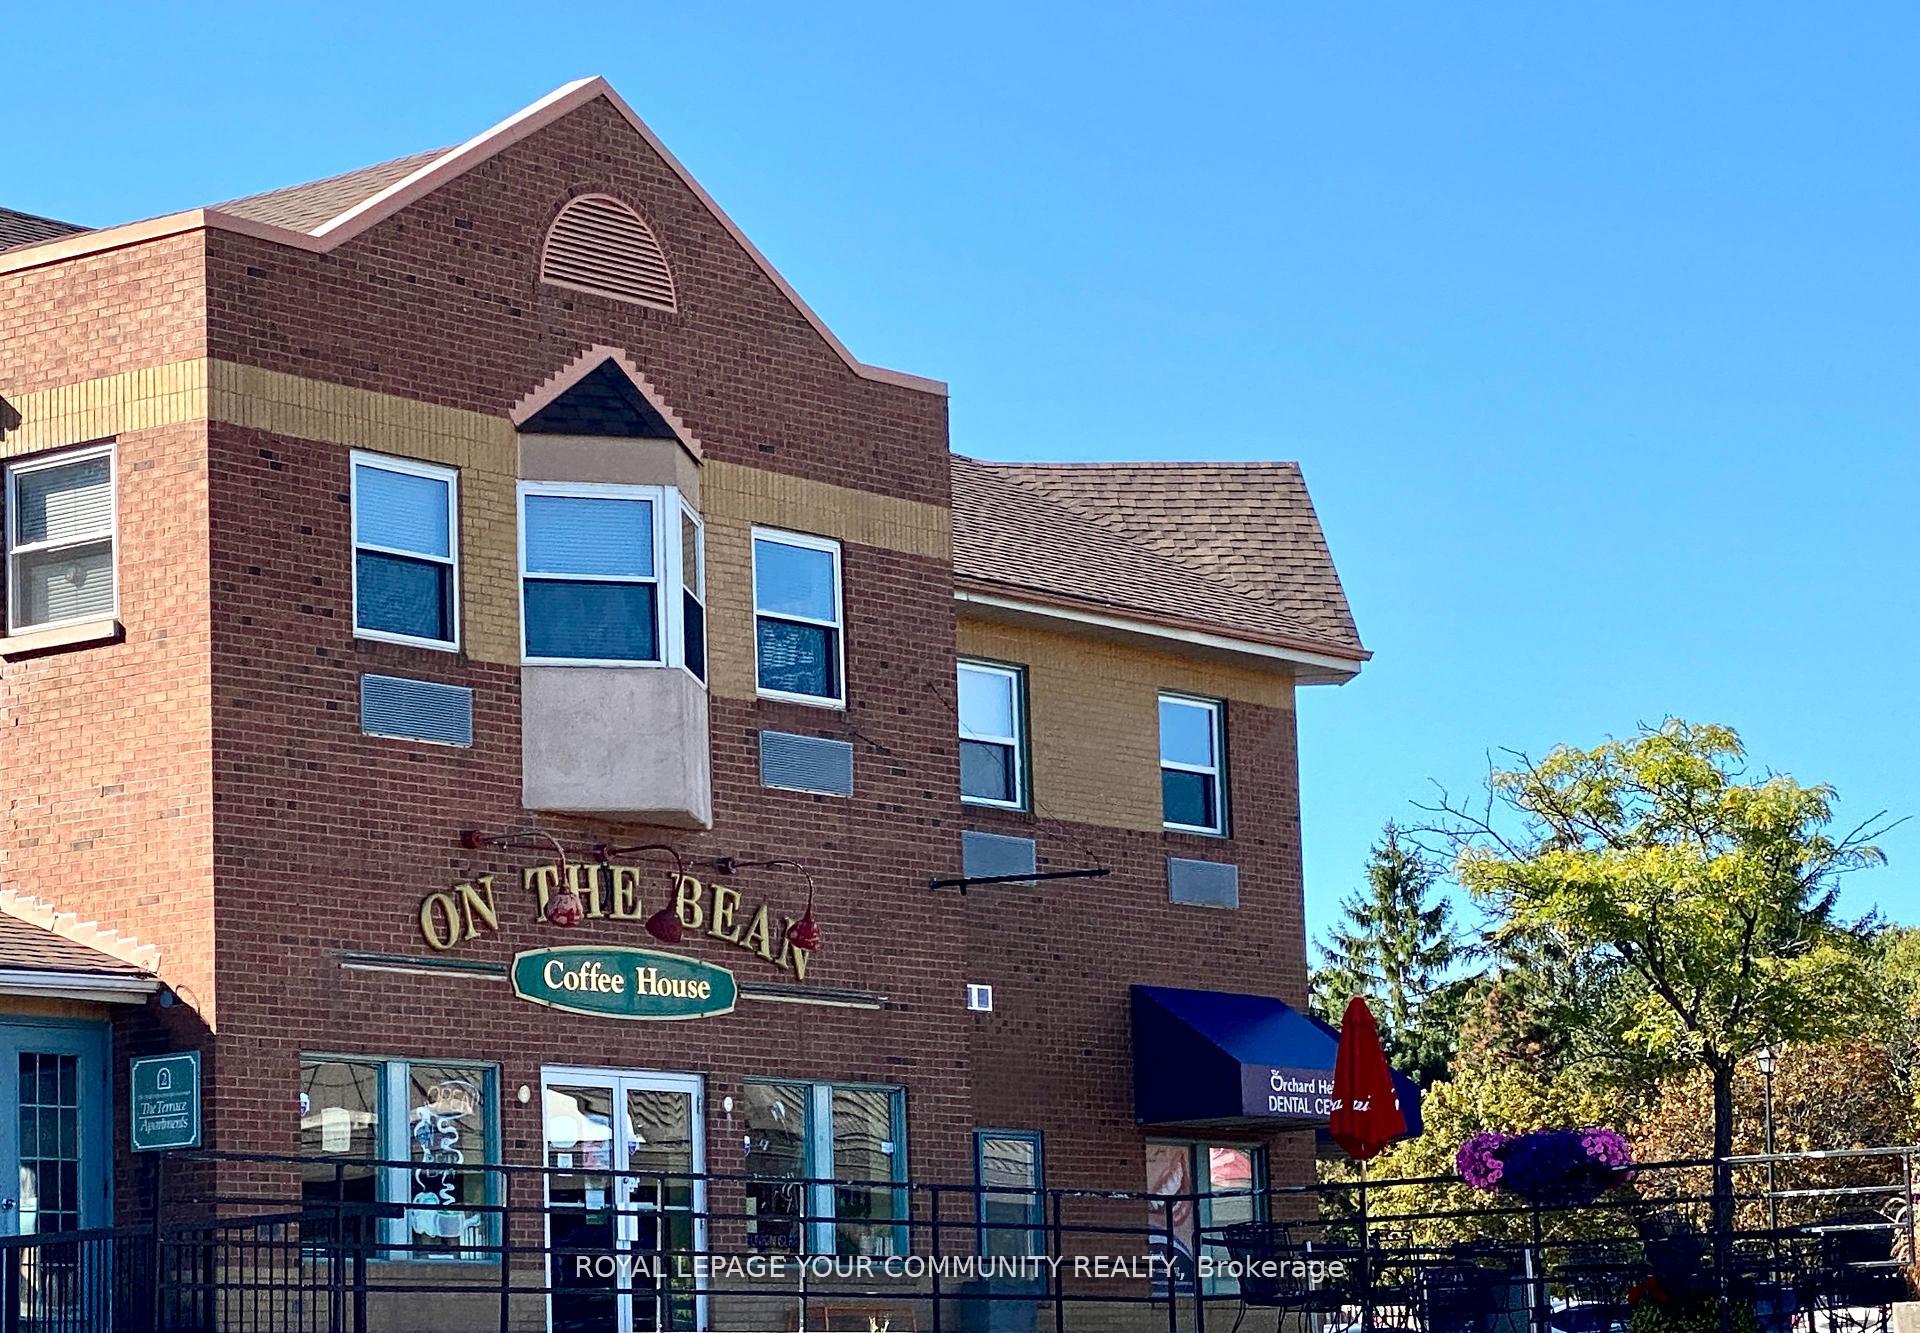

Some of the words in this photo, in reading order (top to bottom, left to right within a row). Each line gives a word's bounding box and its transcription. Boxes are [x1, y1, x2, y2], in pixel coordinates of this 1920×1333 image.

[420, 875, 499, 951] ON
[522, 864, 642, 923] THE
[671, 872, 817, 980] BEAN
[543, 959, 625, 994] Coffee
[635, 966, 711, 1000] House
[160, 1073, 168, 1086] 2
[1270, 1069, 1315, 1095] Orchard
[427, 1085, 476, 1115] OPEN
[1268, 1095, 1312, 1114] DENTAL
[139, 1116, 189, 1134] Apartments
